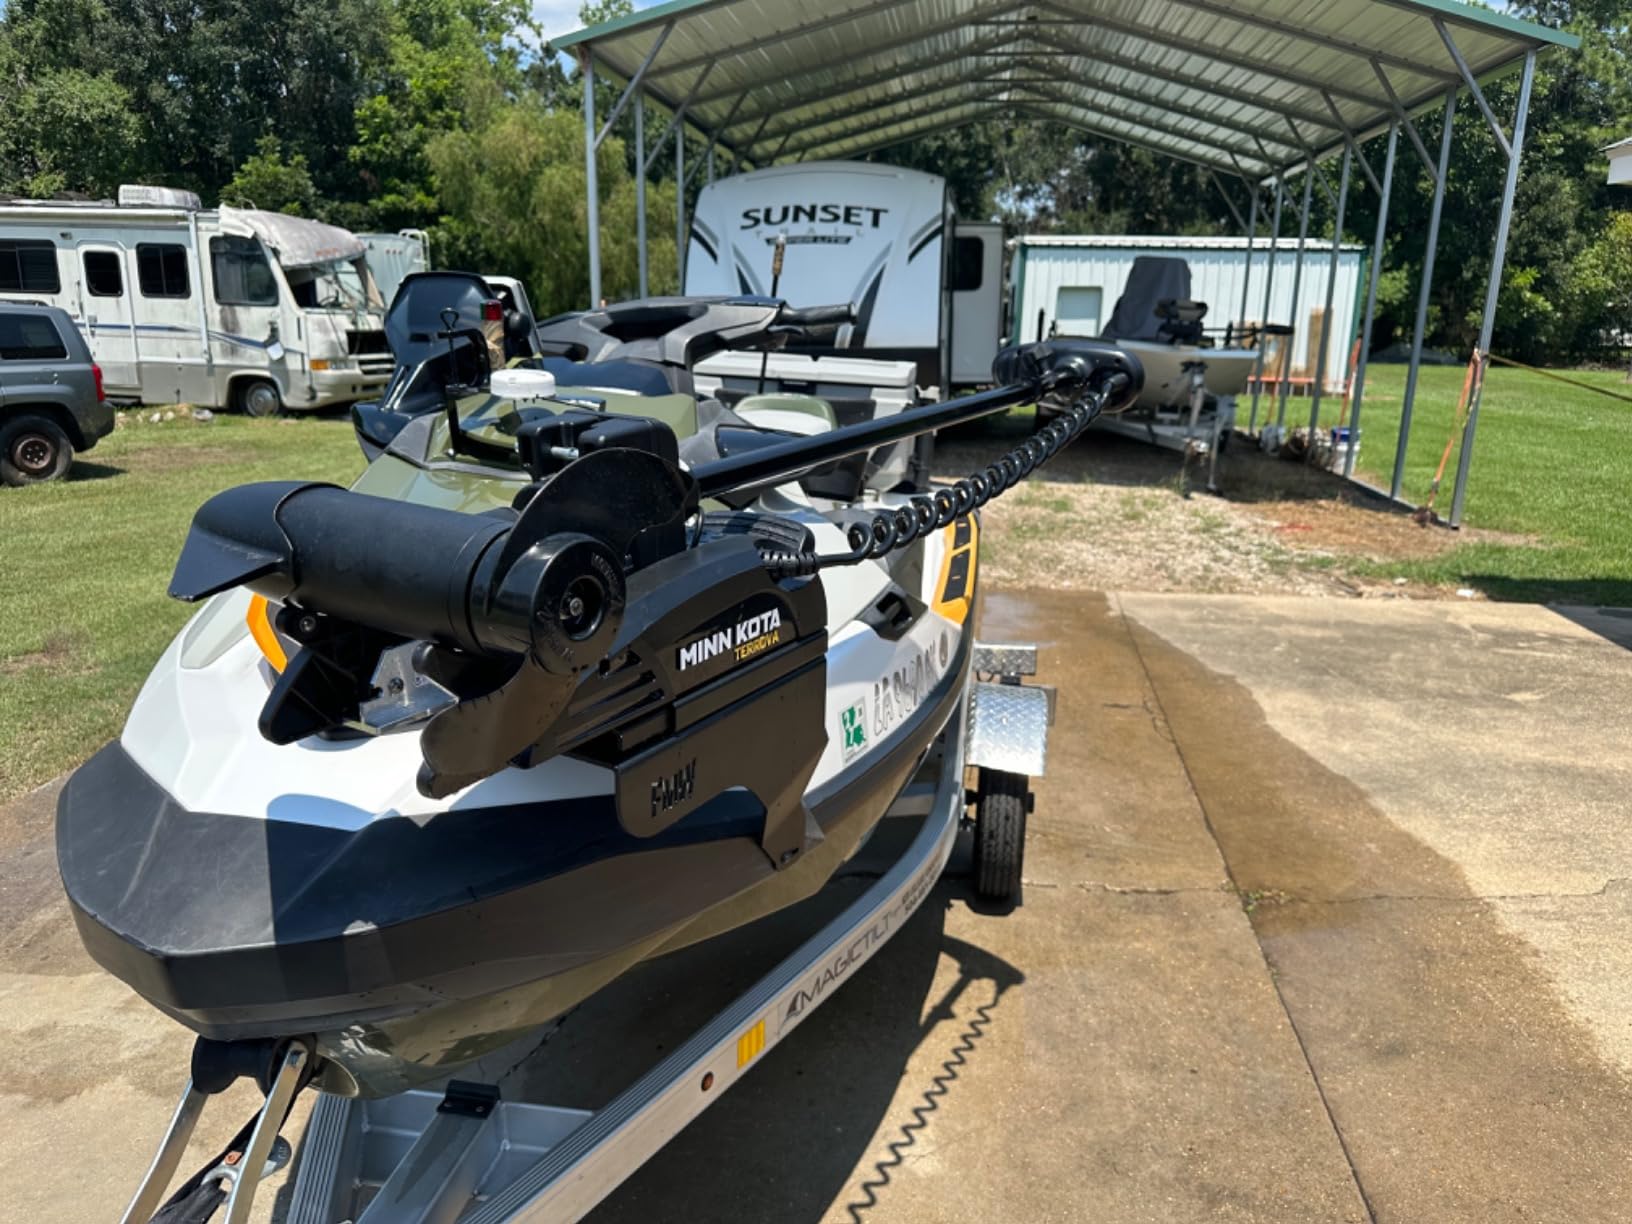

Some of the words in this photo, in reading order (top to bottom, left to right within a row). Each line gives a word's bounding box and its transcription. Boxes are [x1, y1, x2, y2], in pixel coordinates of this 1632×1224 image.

[740, 204, 889, 230] SUNSET
[678, 627, 732, 671] MINN
[736, 607, 781, 645] KOTA
[734, 630, 780, 661] TERROVA
